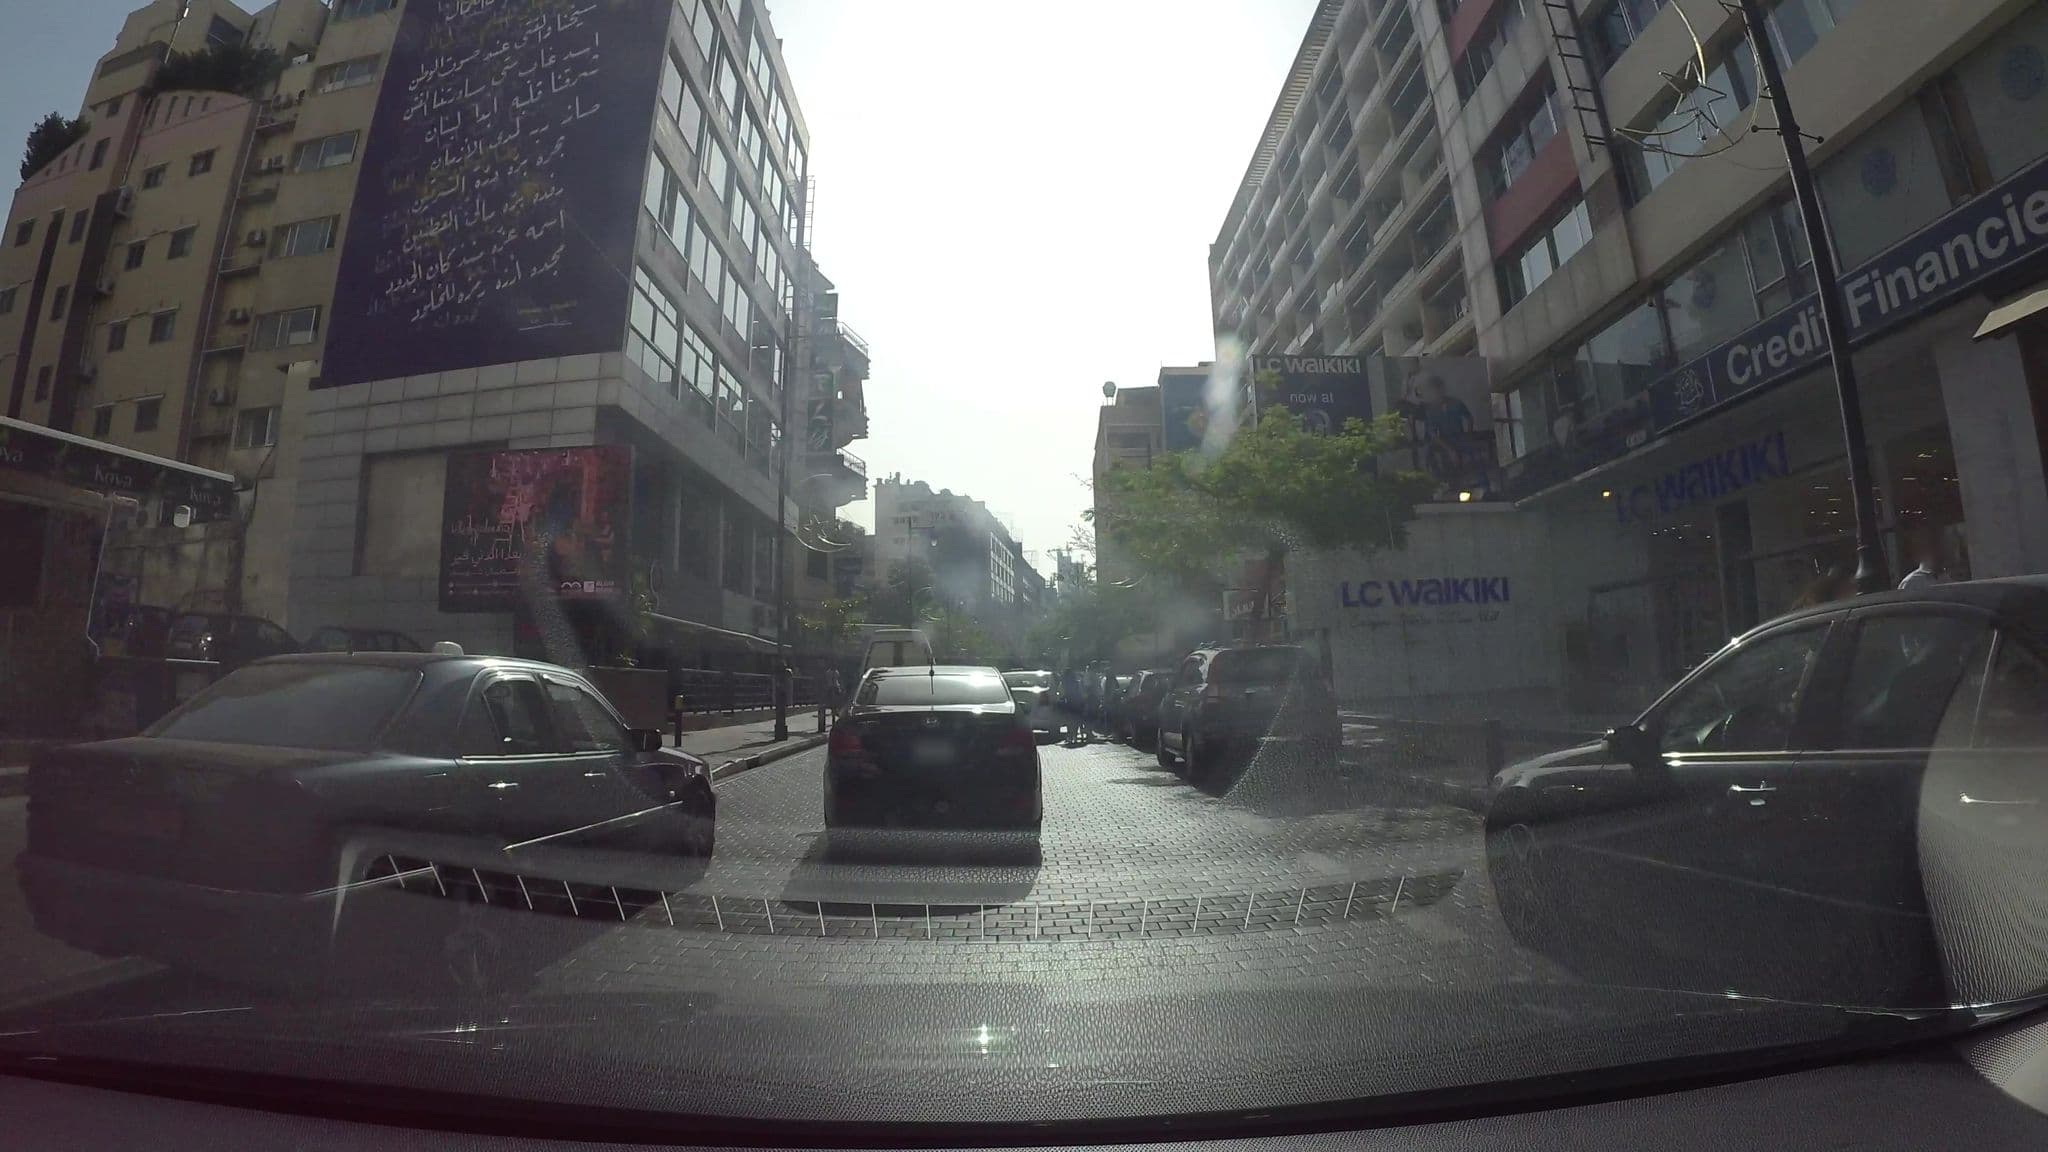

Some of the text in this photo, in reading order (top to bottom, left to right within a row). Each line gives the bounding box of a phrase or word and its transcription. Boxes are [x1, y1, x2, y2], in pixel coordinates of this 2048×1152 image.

[1727, 305, 1825, 386] Credi
[1290, 391, 1335, 404] now at
[1341, 580, 1385, 608] LC
